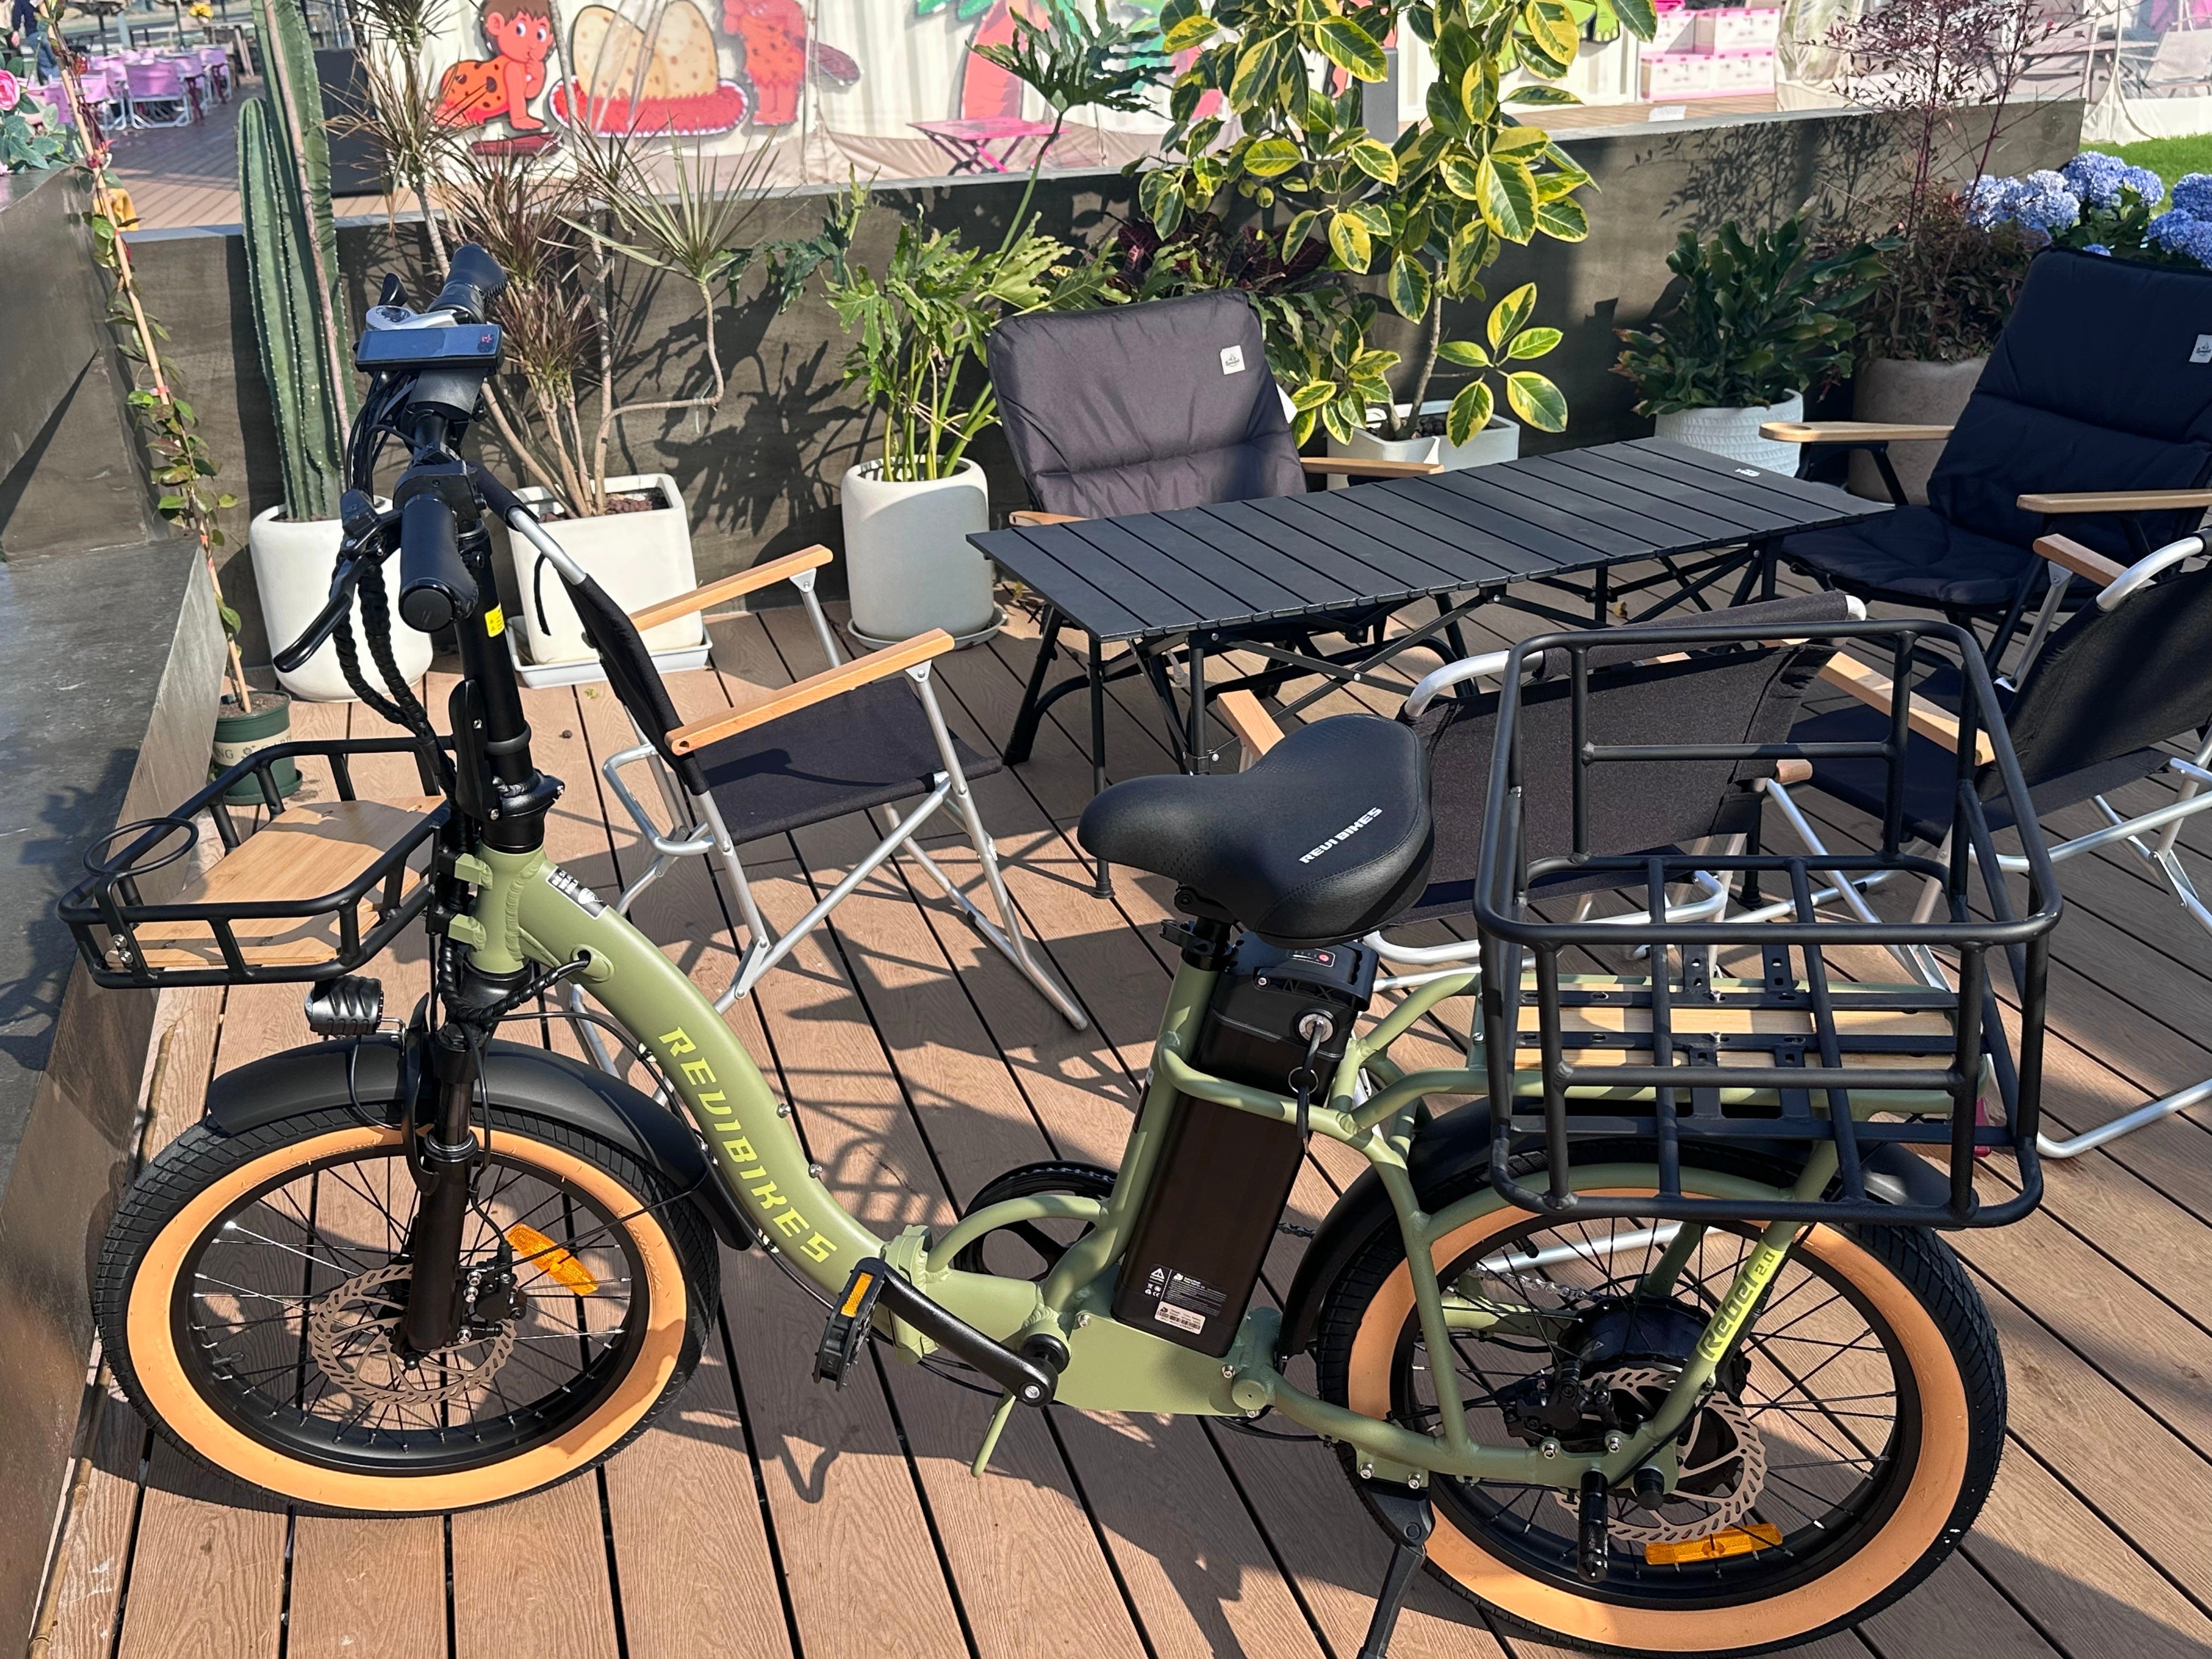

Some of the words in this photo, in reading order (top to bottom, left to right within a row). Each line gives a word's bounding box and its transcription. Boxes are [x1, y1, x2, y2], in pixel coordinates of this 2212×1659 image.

[1334, 807, 1383, 840] BIKES
[658, 1026, 837, 1263] REVIBIKES
[1700, 1269, 1759, 1359] Rebel
[1755, 1250, 1775, 1276] 2.0
